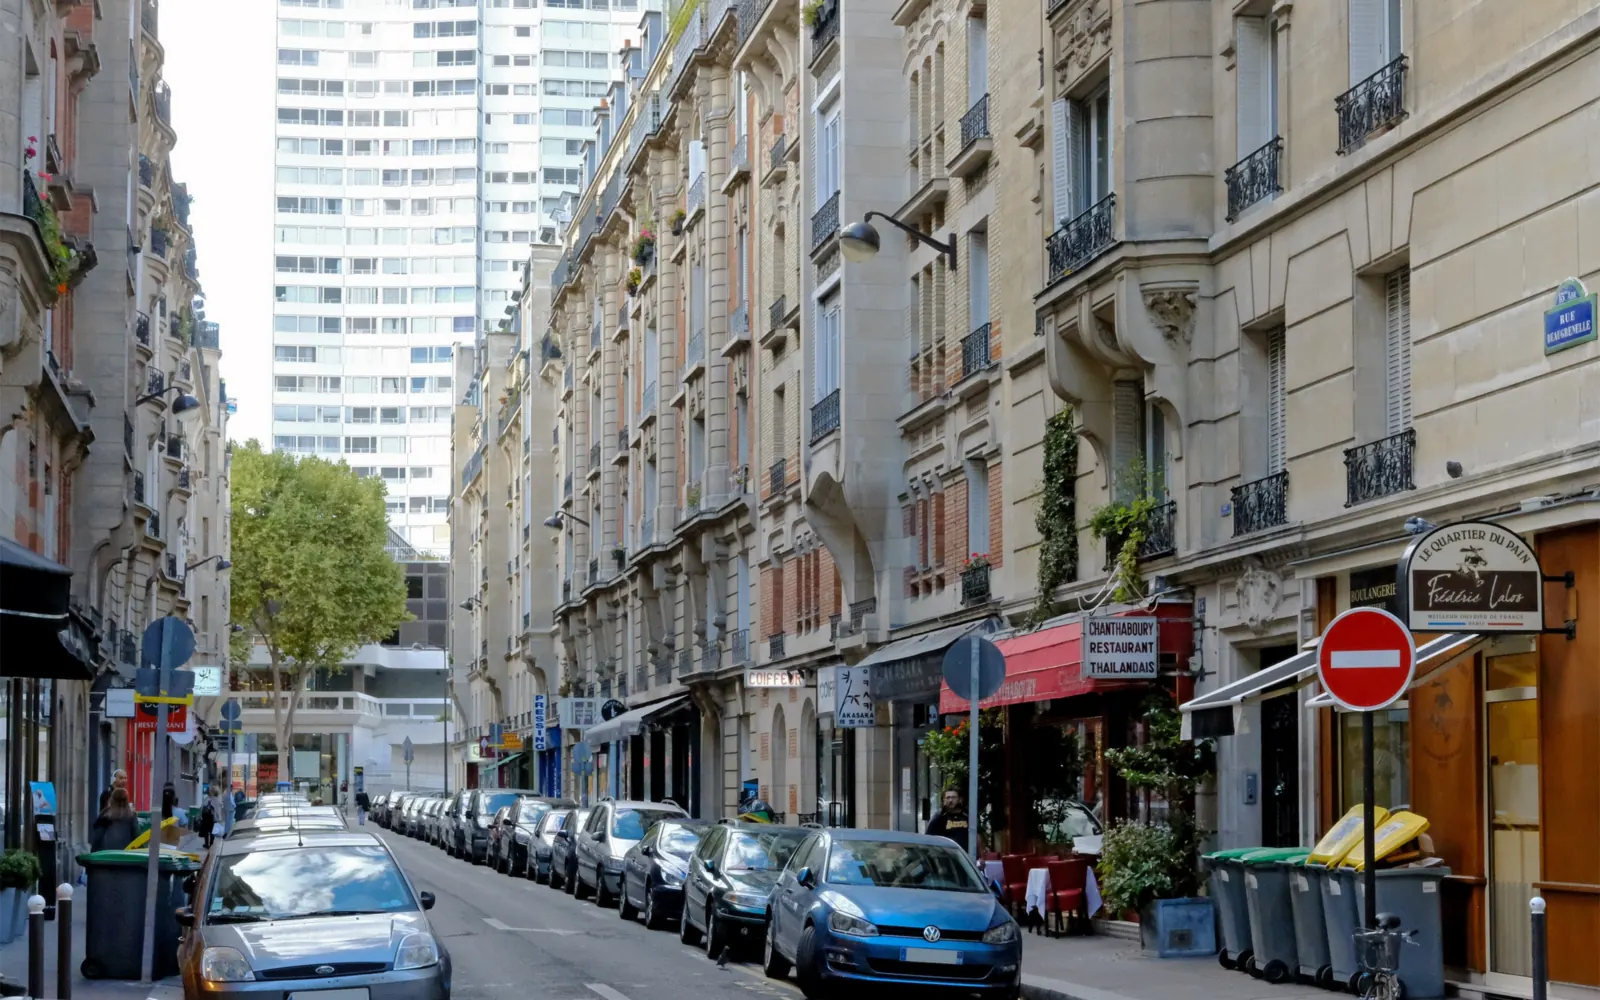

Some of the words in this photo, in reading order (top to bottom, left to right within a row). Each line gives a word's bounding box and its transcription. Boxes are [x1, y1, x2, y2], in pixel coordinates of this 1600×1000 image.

[1560, 311, 1575, 325] RUE
[1547, 320, 1591, 344] BEAUGRENELLE
[1419, 549, 1432, 562] LE
[1431, 529, 1486, 552] QUARTIER
[1489, 531, 1504, 545] DU
[1505, 540, 1531, 564] PAIN
[1351, 582, 1397, 603] BOULANGERIE
[1427, 573, 1482, 608] Frédéric
[1489, 574, 1525, 609] Lalos
[1089, 622, 1154, 636] CHANTHABOURY
[1089, 641, 1154, 654] RESTAURANT
[1090, 661, 1155, 674] THAILANDAIS
[138, 721, 185, 729] RESTARANT
[534, 695, 545, 750] PRESSING
